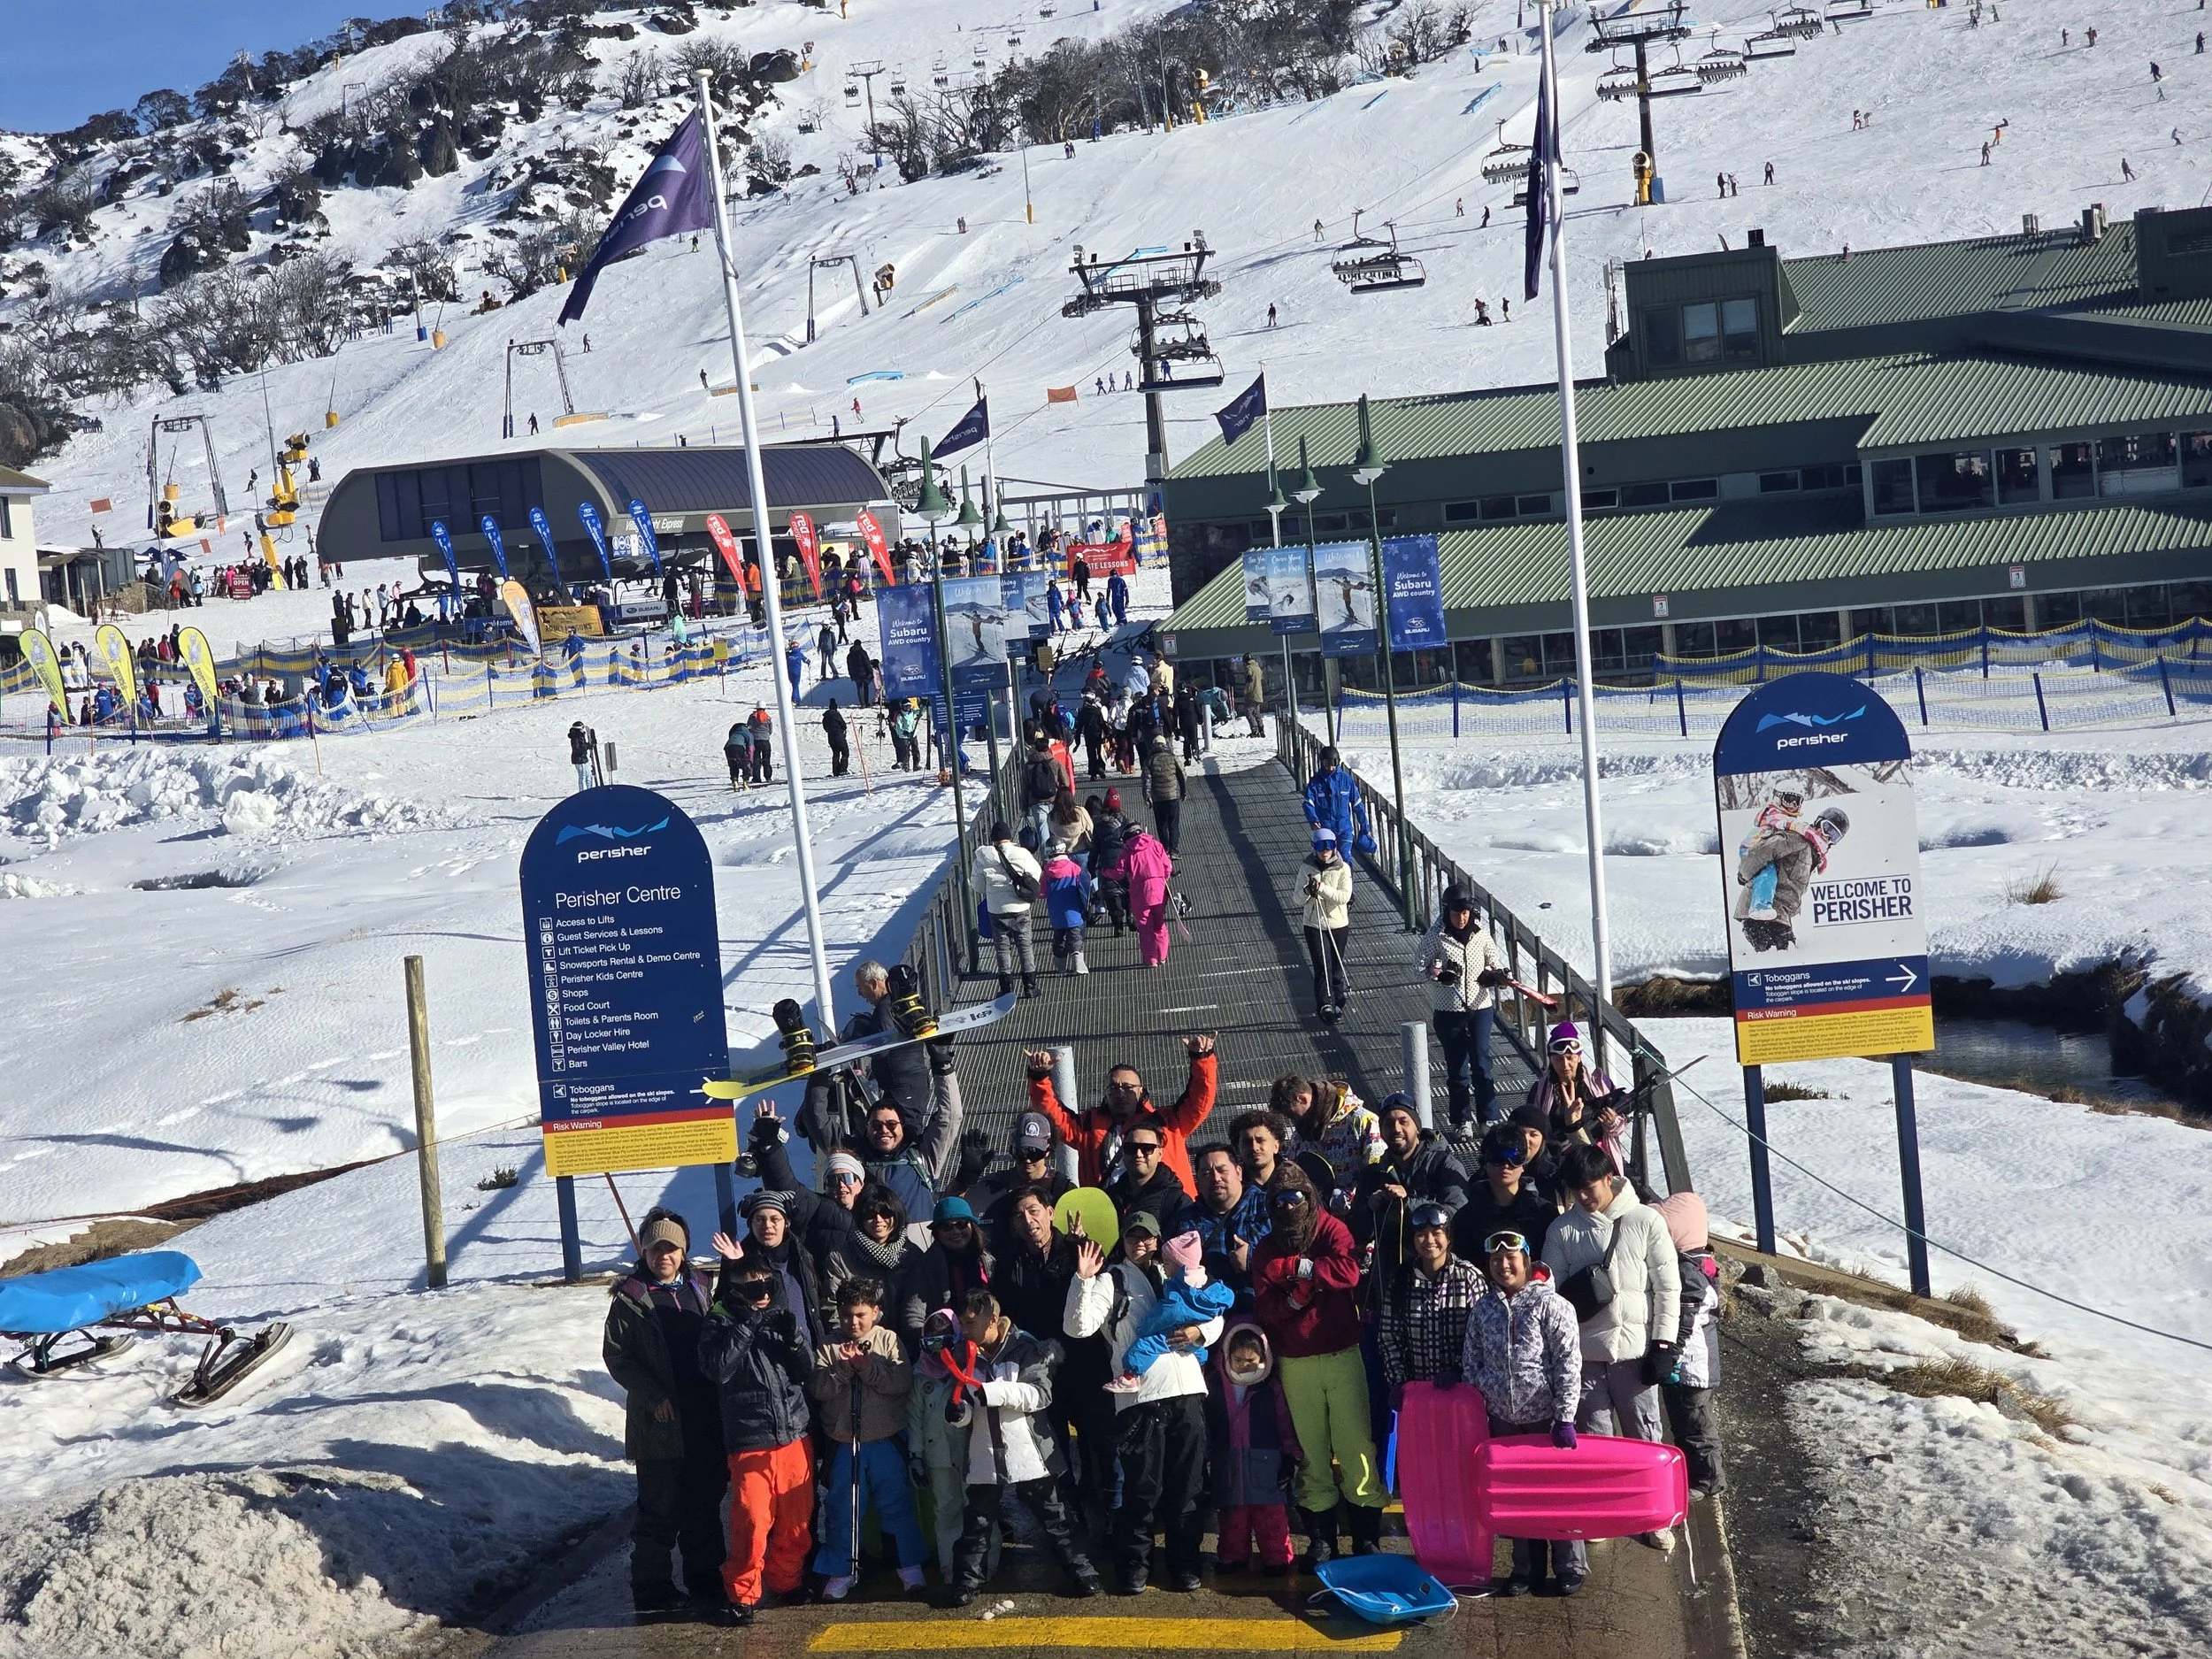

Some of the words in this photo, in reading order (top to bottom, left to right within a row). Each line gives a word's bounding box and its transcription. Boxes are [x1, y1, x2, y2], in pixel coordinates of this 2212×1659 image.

[661, 518, 684, 532] Express
[710, 516, 726, 535] red
[795, 515, 810, 534] red
[860, 513, 877, 533] red
[1394, 580, 1432, 591] Subaru
[892, 618, 917, 628] Welcome
[890, 626, 927, 638] Subaru
[1777, 733, 1848, 751] perisher
[578, 846, 652, 864] perisher
[1810, 878, 1888, 902] WELCOME
[1892, 877, 1912, 895] TO
[556, 889, 621, 909] Perisher
[626, 885, 681, 903] Centre
[1813, 895, 1913, 924] PERISHER
[556, 918, 586, 928] Access
[597, 916, 615, 925] Lifts
[557, 932, 582, 942] Guest
[583, 929, 618, 940] Services
[620, 928, 627, 937] &
[629, 926, 664, 936] Lessons
[558, 947, 572, 956] Lift
[572, 944, 597, 955] Ticket
[599, 943, 617, 953] Pick
[618, 942, 631, 952] Up
[559, 959, 608, 971] Snowsports
[610, 956, 635, 966] Rental
[646, 953, 672, 964] Demo
[673, 951, 701, 961] Centre
[561, 974, 595, 985] Perisher
[595, 972, 614, 981] Kids
[616, 970, 643, 979] Centre
[1764, 972, 1811, 983] Toboggans
[562, 989, 588, 999] Shops
[564, 1002, 585, 1012] Food
[587, 1001, 611, 1010] Court
[565, 1016, 591, 1026] Toilets
[601, 1013, 632, 1023] Parents
[634, 1011, 659, 1021] Room
[1747, 1010, 1764, 1019] Risk
[1765, 1009, 1797, 1019] Warning
[566, 1031, 582, 1041] Day
[584, 1029, 611, 1039] Locker
[613, 1027, 631, 1036] Hire
[567, 1044, 600, 1054] Perisher
[602, 1041, 626, 1053] Valley
[627, 1040, 649, 1049] Hotel
[568, 1060, 588, 1069] Bars
[569, 1084, 615, 1094] Toboggans
[553, 1122, 570, 1131] Risk
[571, 1120, 603, 1132] Warning
